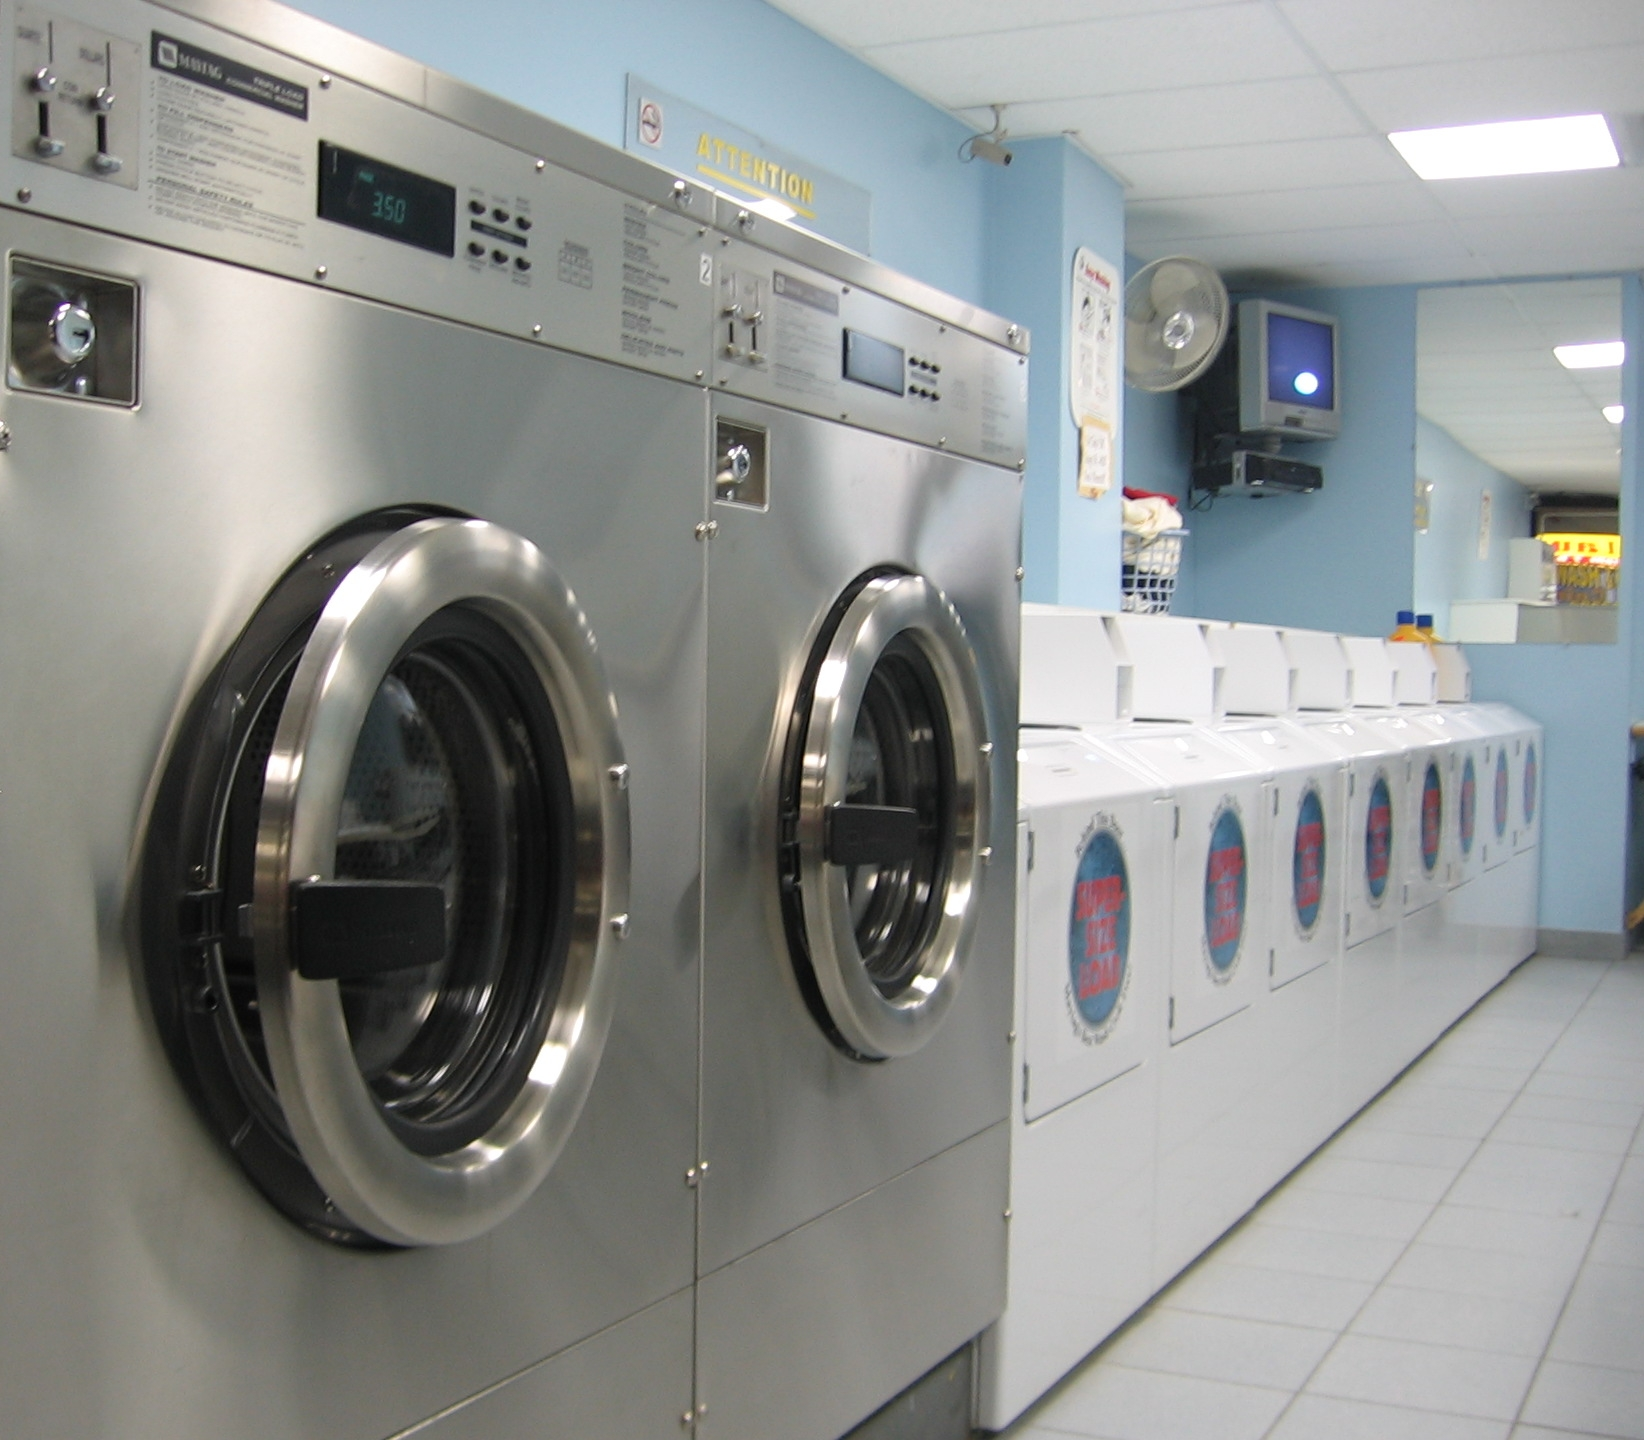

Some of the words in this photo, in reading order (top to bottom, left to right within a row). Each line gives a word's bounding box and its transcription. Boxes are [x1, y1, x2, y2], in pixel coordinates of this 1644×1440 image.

[697, 133, 814, 204] ATTENTION
[370, 191, 406, 224] 350
[701, 257, 712, 283] 2
